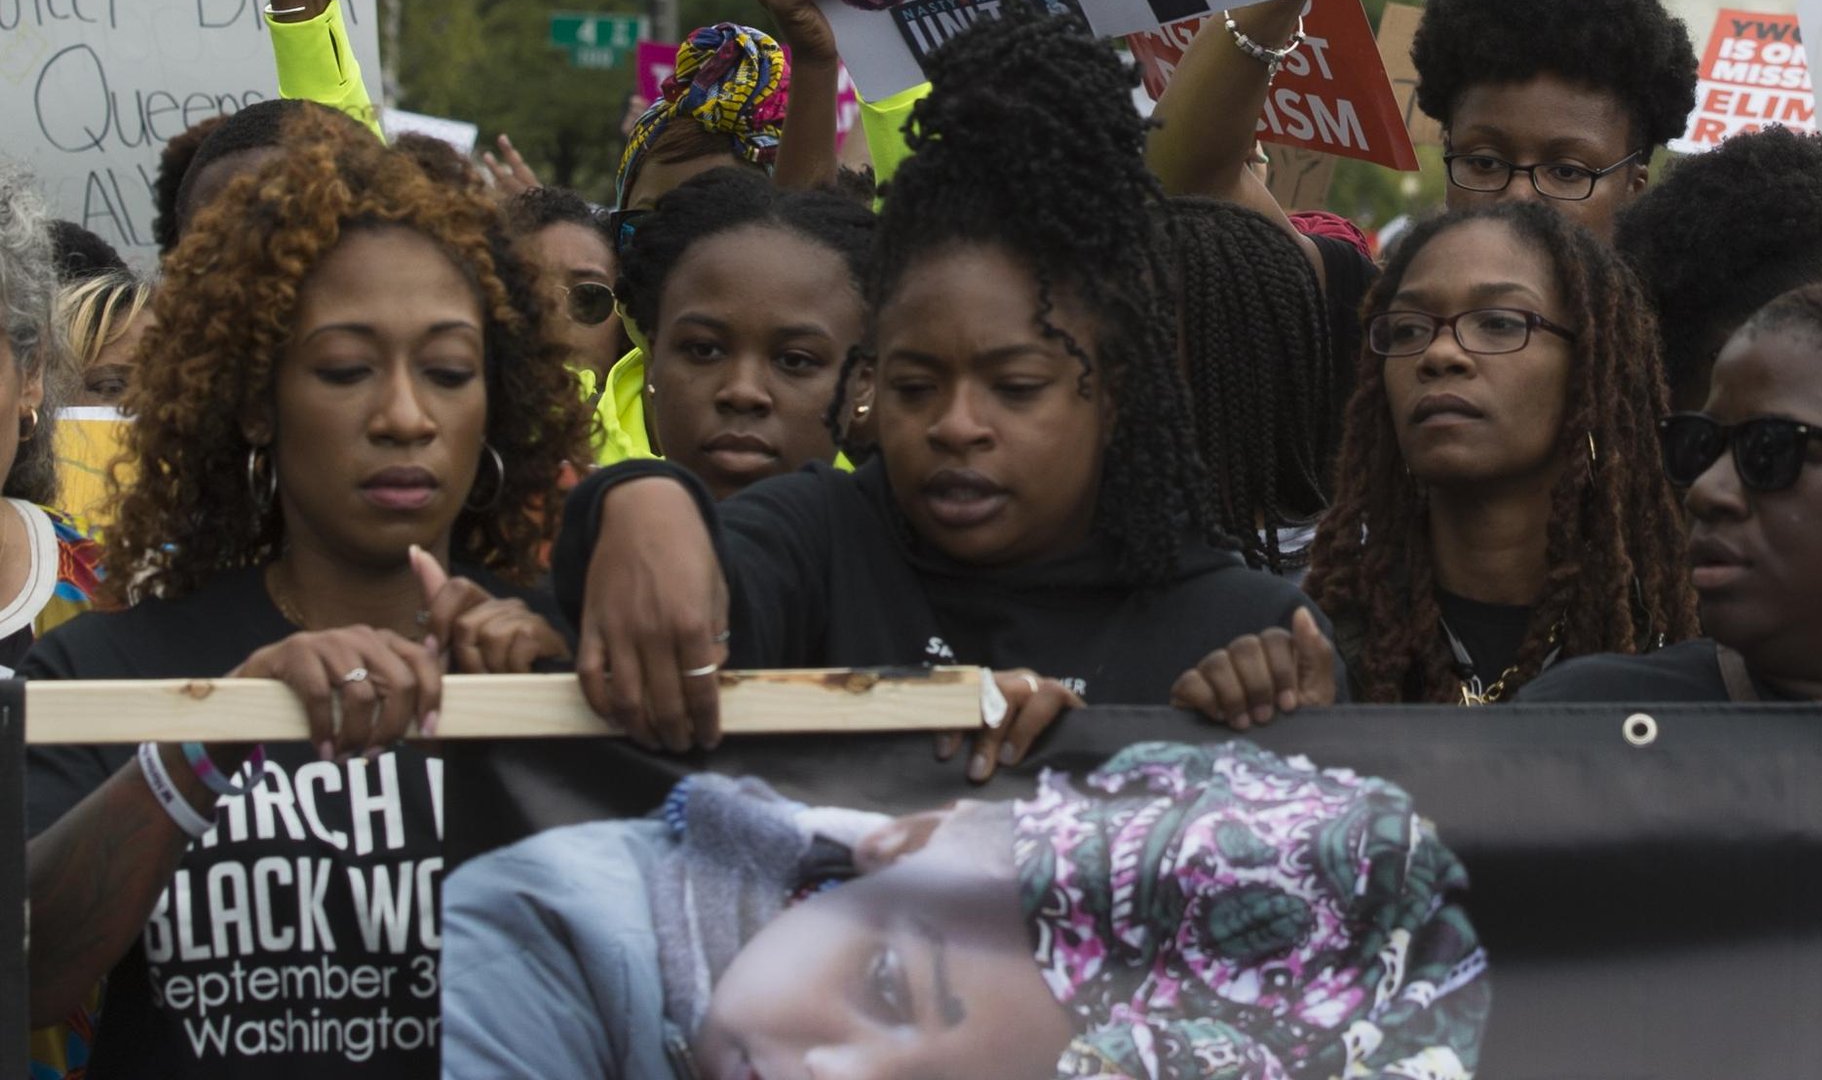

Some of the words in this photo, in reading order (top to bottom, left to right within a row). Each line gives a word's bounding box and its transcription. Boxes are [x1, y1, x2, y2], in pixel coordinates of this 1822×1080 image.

[1719, 38, 1758, 61] IS
[1257, 87, 1370, 151] ISM
[187, 752, 404, 855] ARCH
[144, 856, 337, 962] BLACK
[410, 957, 443, 999] 3
